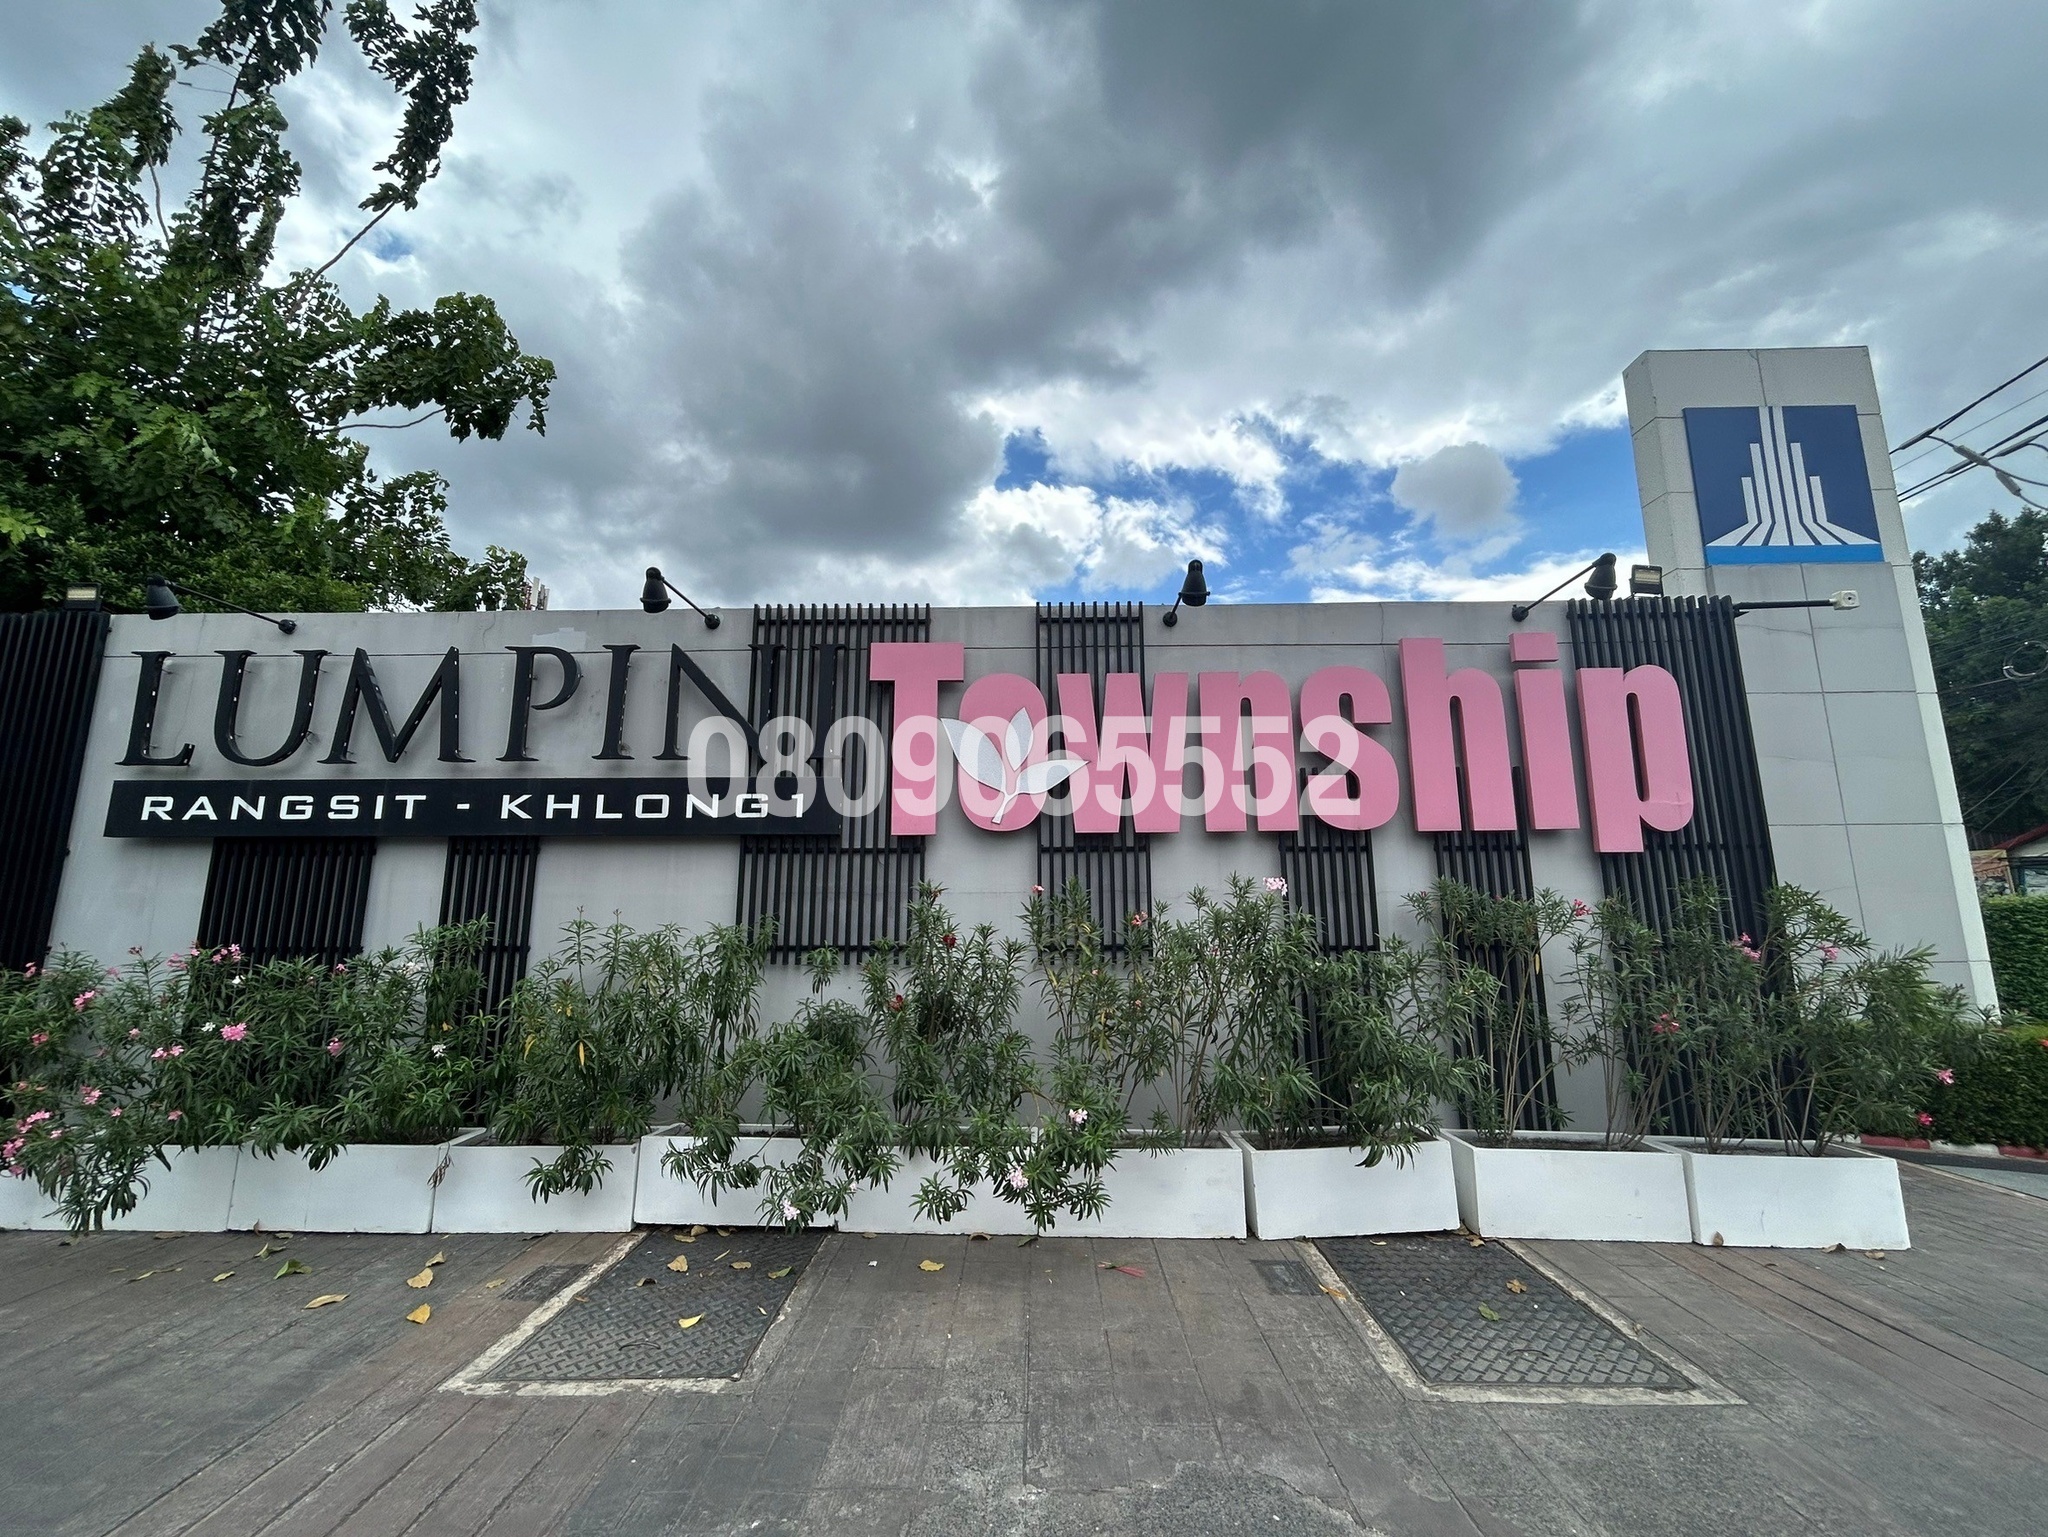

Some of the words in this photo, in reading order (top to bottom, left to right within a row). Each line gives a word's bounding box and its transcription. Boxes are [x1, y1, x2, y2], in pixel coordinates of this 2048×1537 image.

[116, 645, 847, 767] LUMPINI
[869, 633, 1695, 854] Township
[140, 794, 428, 821] RANGSIT
